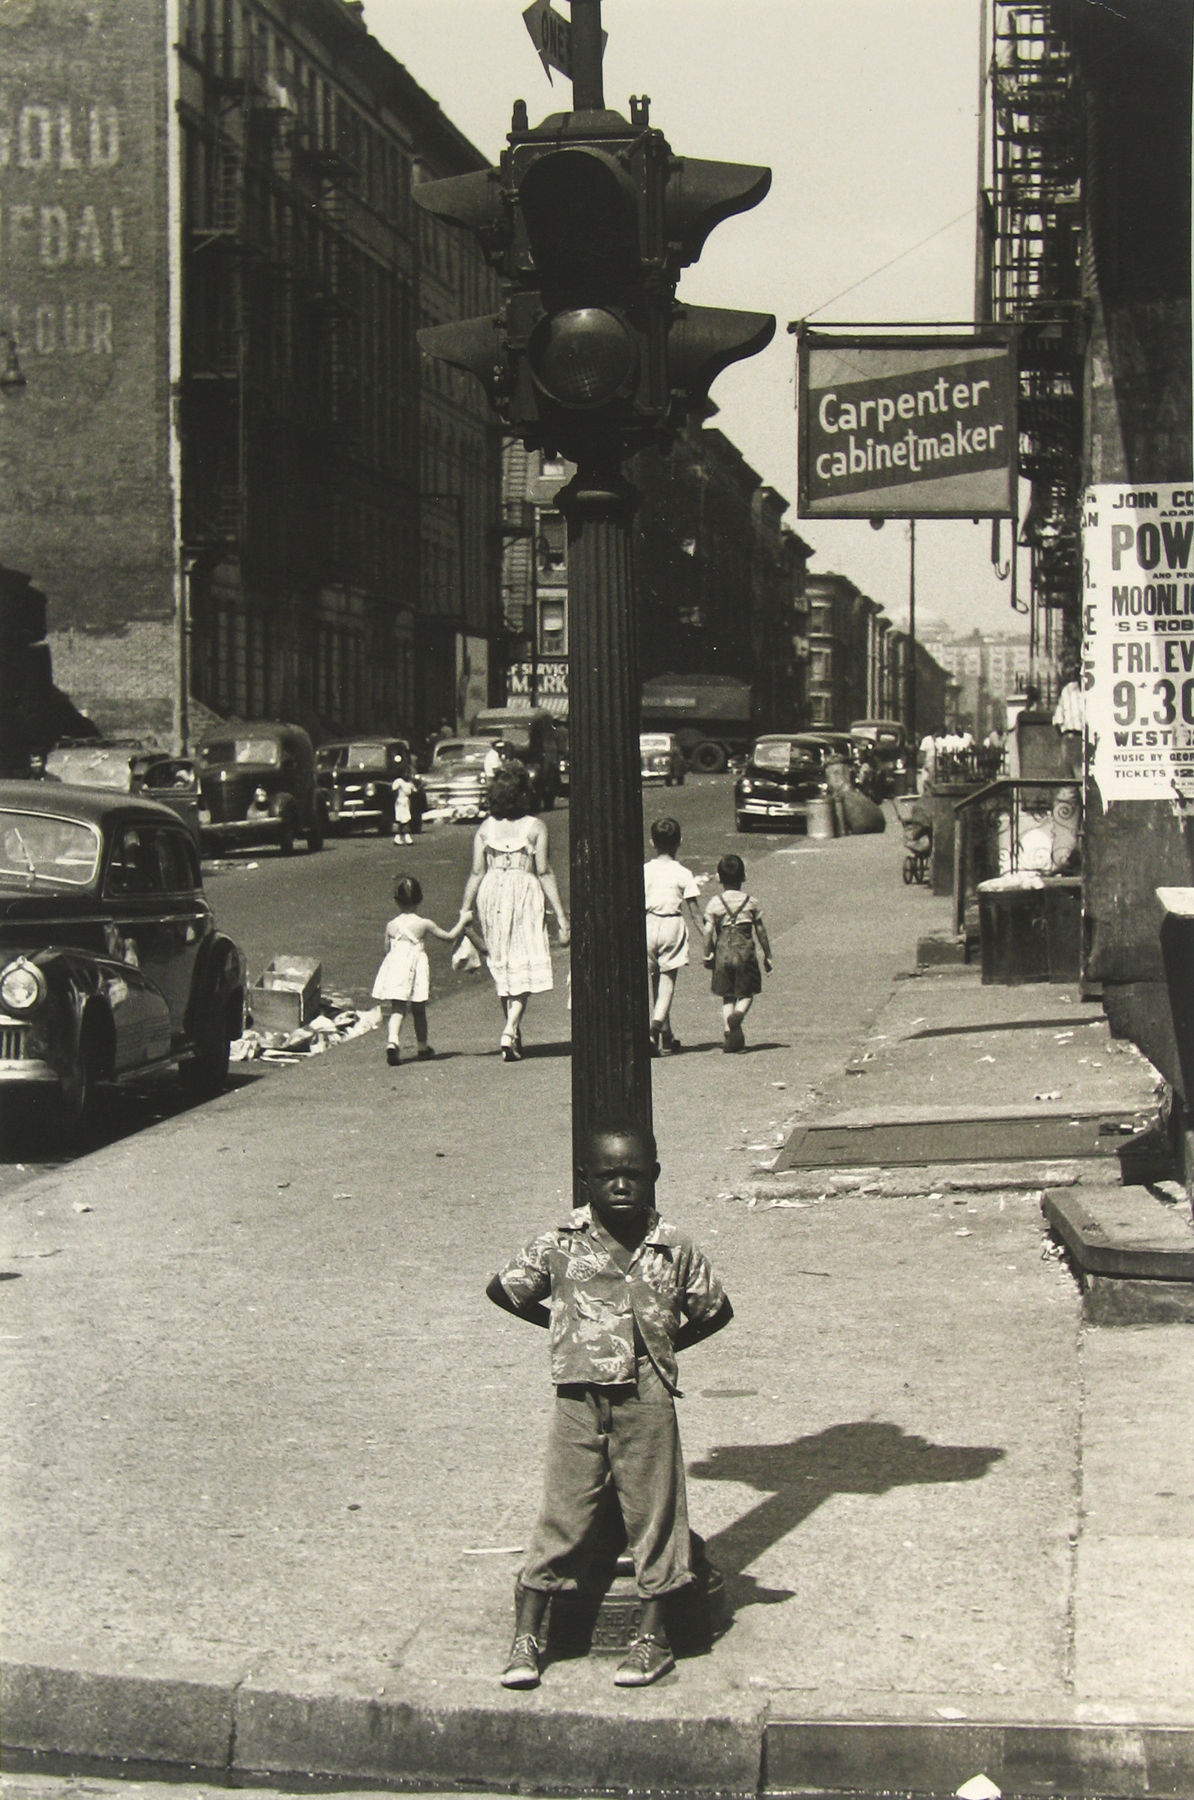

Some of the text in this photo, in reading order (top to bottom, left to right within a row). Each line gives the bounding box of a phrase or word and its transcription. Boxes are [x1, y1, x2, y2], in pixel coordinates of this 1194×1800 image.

[541, 9, 566, 63] ONE
[819, 376, 990, 434] Carpenter
[816, 420, 1003, 479] cabinetmaker
[1111, 491, 1158, 509] JOIN
[1111, 521, 1193, 571] POW
[1154, 619, 1193, 632] ROB
[1112, 641, 1159, 674] FRI.
[1113, 730, 1173, 747] WEST
[1113, 753, 1145, 762] MUSIC
[1150, 753, 1162, 762] BY
[1114, 769, 1166, 778] TICKETS
